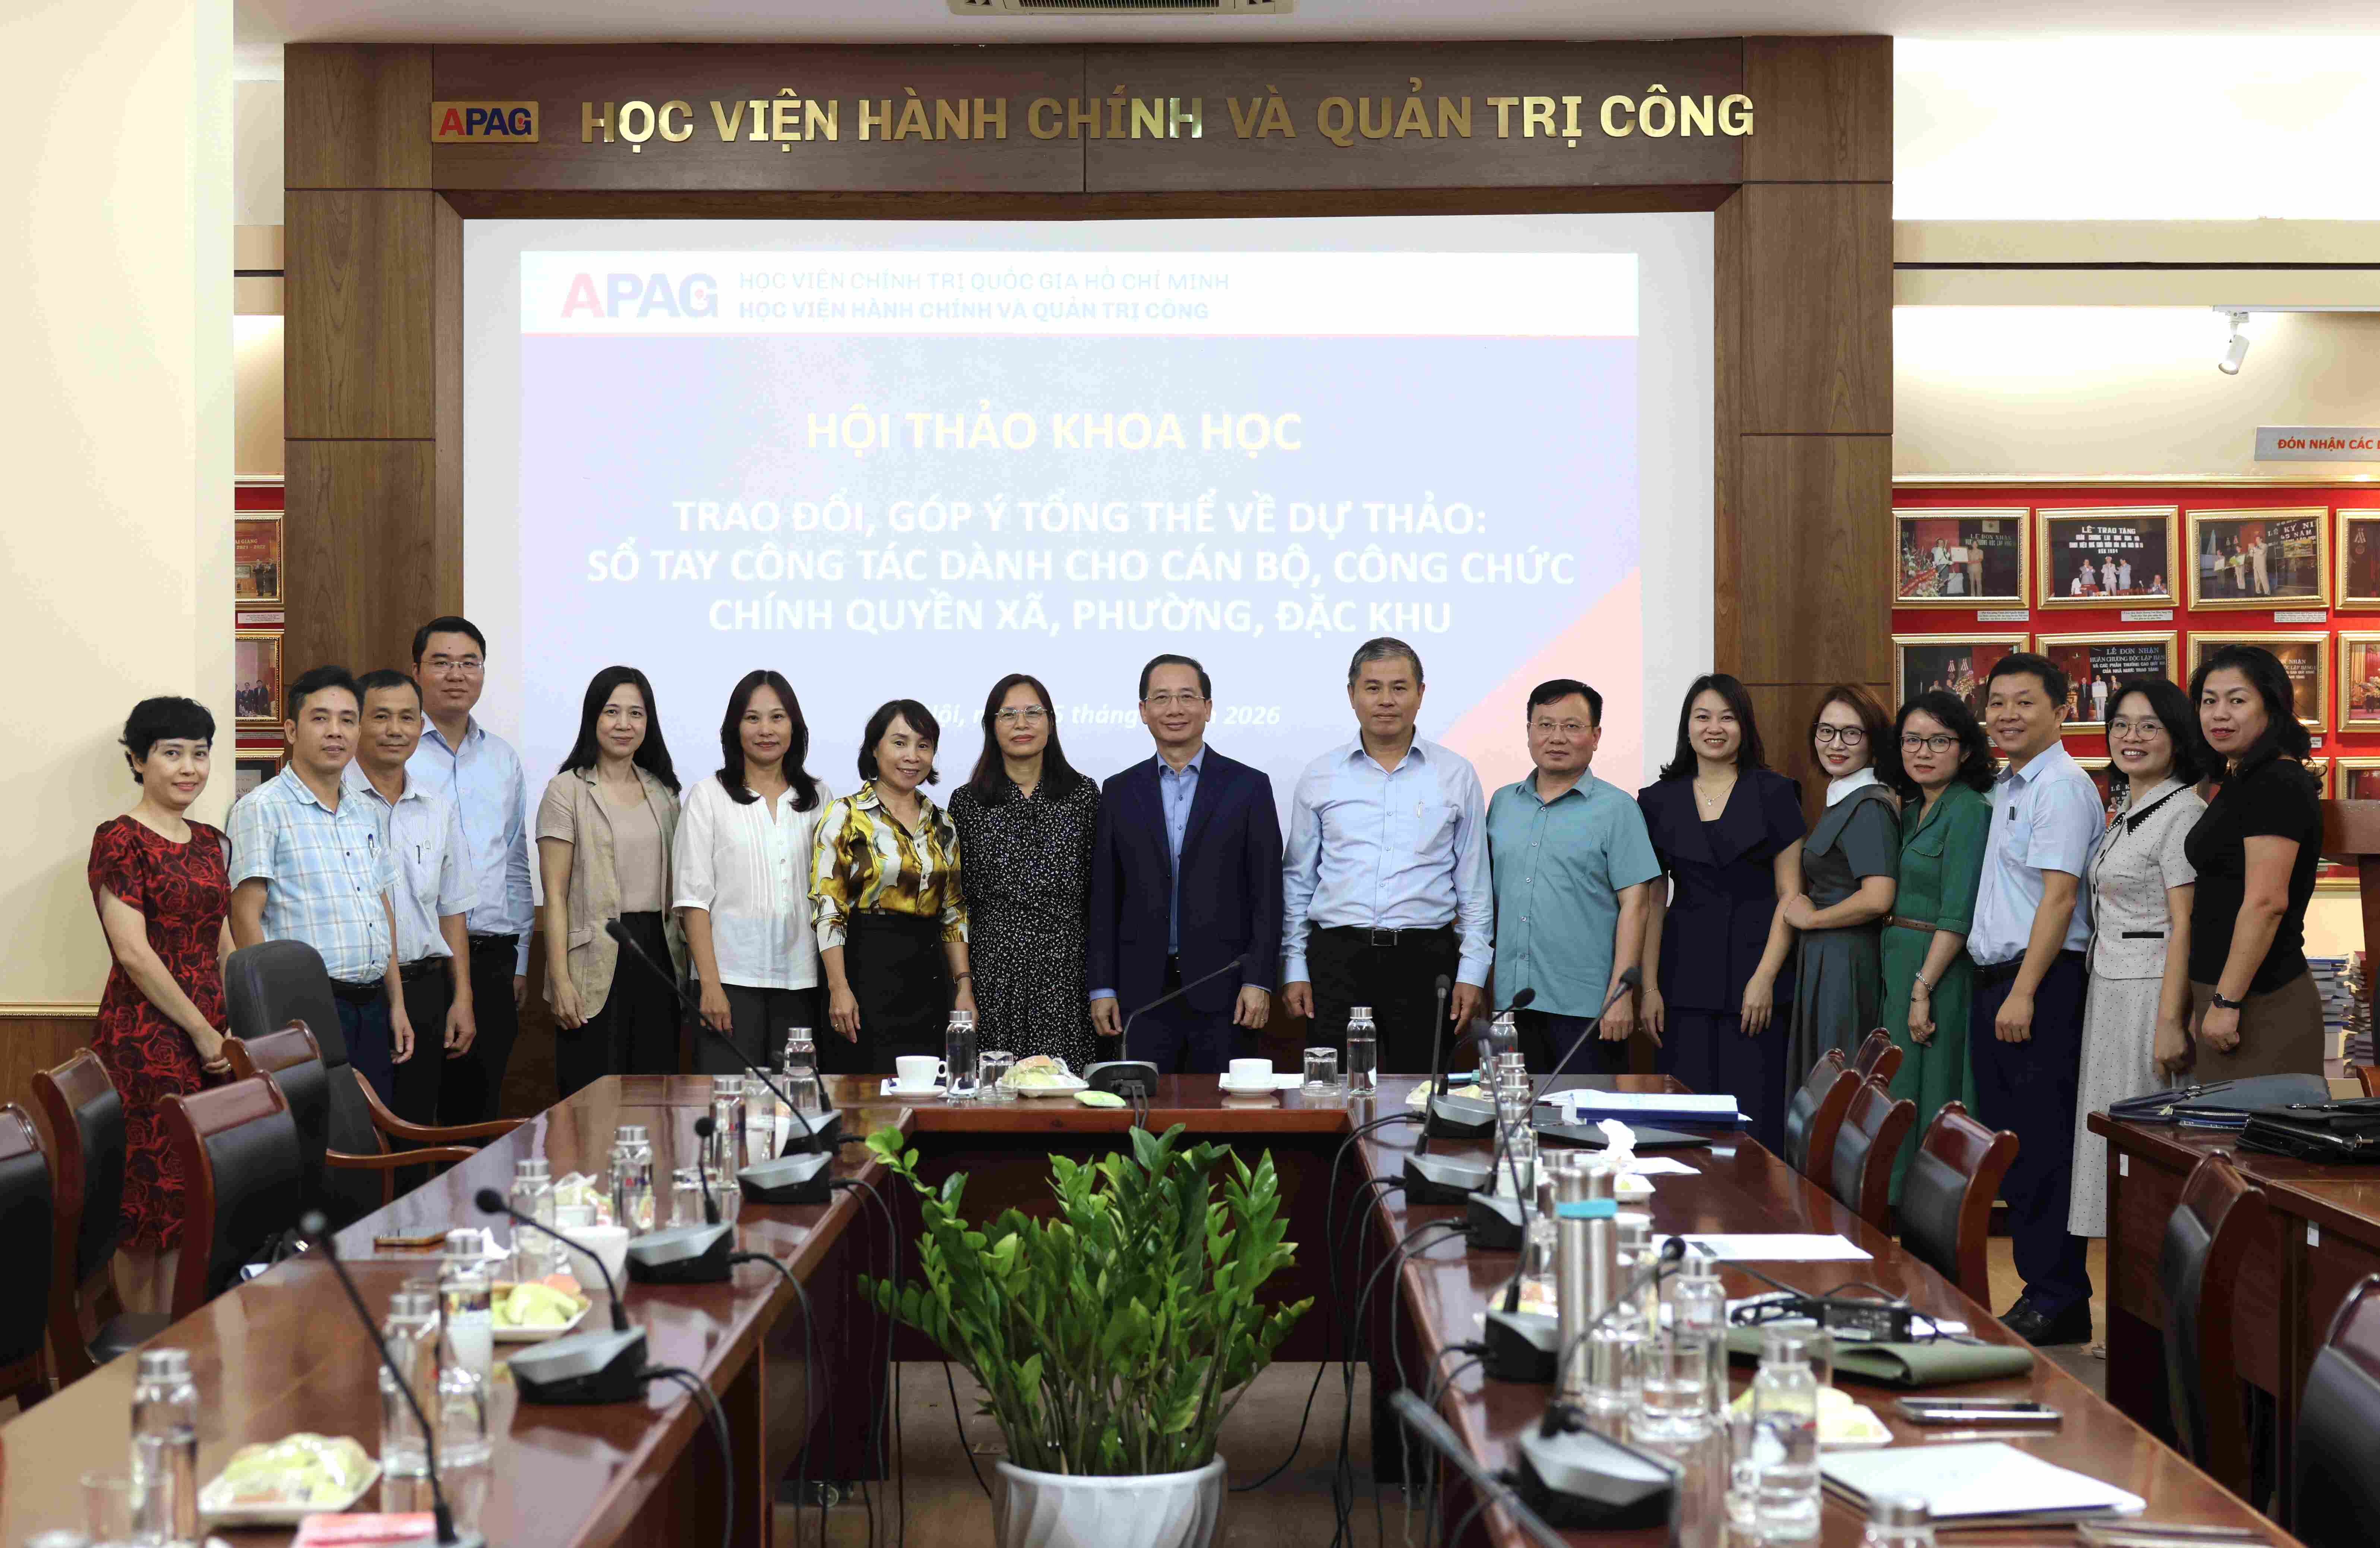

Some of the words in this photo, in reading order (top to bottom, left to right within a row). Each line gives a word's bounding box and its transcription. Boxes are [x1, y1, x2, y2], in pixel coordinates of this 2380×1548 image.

[439, 108, 531, 136] APAG
[581, 100, 693, 153] HỌC
[709, 88, 838, 152] VIỆN
[859, 87, 1006, 140] HÀNH
[1028, 85, 1202, 139] CHÍNH
[1227, 85, 1295, 138] VÀ
[1317, 77, 1471, 147] QUẢN
[1487, 95, 1582, 148] TRỊ
[1600, 84, 1754, 138] CÔNG
[561, 273, 718, 318] APAG
[739, 272, 787, 292] HỌC
[792, 269, 844, 292] VIỆN
[851, 269, 921, 290] CHÍNH
[927, 272, 963, 292] TRỊ
[971, 265, 1033, 292] QUỐC
[1040, 272, 1079, 290] GIA
[1085, 265, 1115, 290] HỒ
[1121, 269, 1160, 290] CHÍ
[1168, 273, 1229, 290] MINH
[739, 302, 787, 322] HỌC
[792, 298, 845, 322] VIỆN
[852, 297, 913, 318] HÀNH
[919, 298, 992, 318] CHÍNH
[996, 298, 1027, 318] VÀ
[1033, 296, 1096, 321] QUẢN
[1102, 302, 1139, 322] TRỊ
[1145, 298, 1208, 318] CÔNG
[807, 404, 889, 458] HỘI
[905, 400, 1036, 449] THẢO
[1054, 413, 1186, 449] KHOA
[1202, 413, 1301, 458] HỌC
[2278, 436, 2305, 449] ĐÓN
[2310, 436, 2345, 451] NHẬN
[2349, 436, 2373, 449] CÁC
[673, 500, 779, 531] TRAO
[793, 489, 875, 537] ĐỔI,
[889, 494, 971, 531] GÓP
[984, 493, 1011, 530] Ý
[1019, 488, 1128, 533] TỔNG
[1142, 487, 1215, 532] THỂ
[1228, 491, 1276, 532] VỀ
[1290, 501, 1353, 539] DỰ
[1362, 493, 1485, 533] THẢO:
[588, 537, 639, 581] SỔ
[651, 550, 718, 580] TAY
[730, 542, 843, 581] CÔNG
[856, 542, 927, 581] TÁC
[940, 542, 1052, 580] DÀNH
[1065, 551, 1148, 581] CHO
[1161, 544, 1241, 581] CÁN
[1257, 544, 1321, 588] BỘ,
[1334, 545, 1448, 583] CÔNG
[1461, 545, 1574, 584] CHỨC
[709, 592, 833, 630] CHÍNH
[846, 589, 983, 636] QUYỀN
[996, 593, 1060, 637] XÃ,
[1073, 593, 1264, 637] PHƯỜNG,
[1276, 593, 1356, 637] ĐẶC
[1370, 602, 1450, 631] KHU
[1071, 704, 1139, 728] tháng
[1222, 707, 1280, 725] 2026
